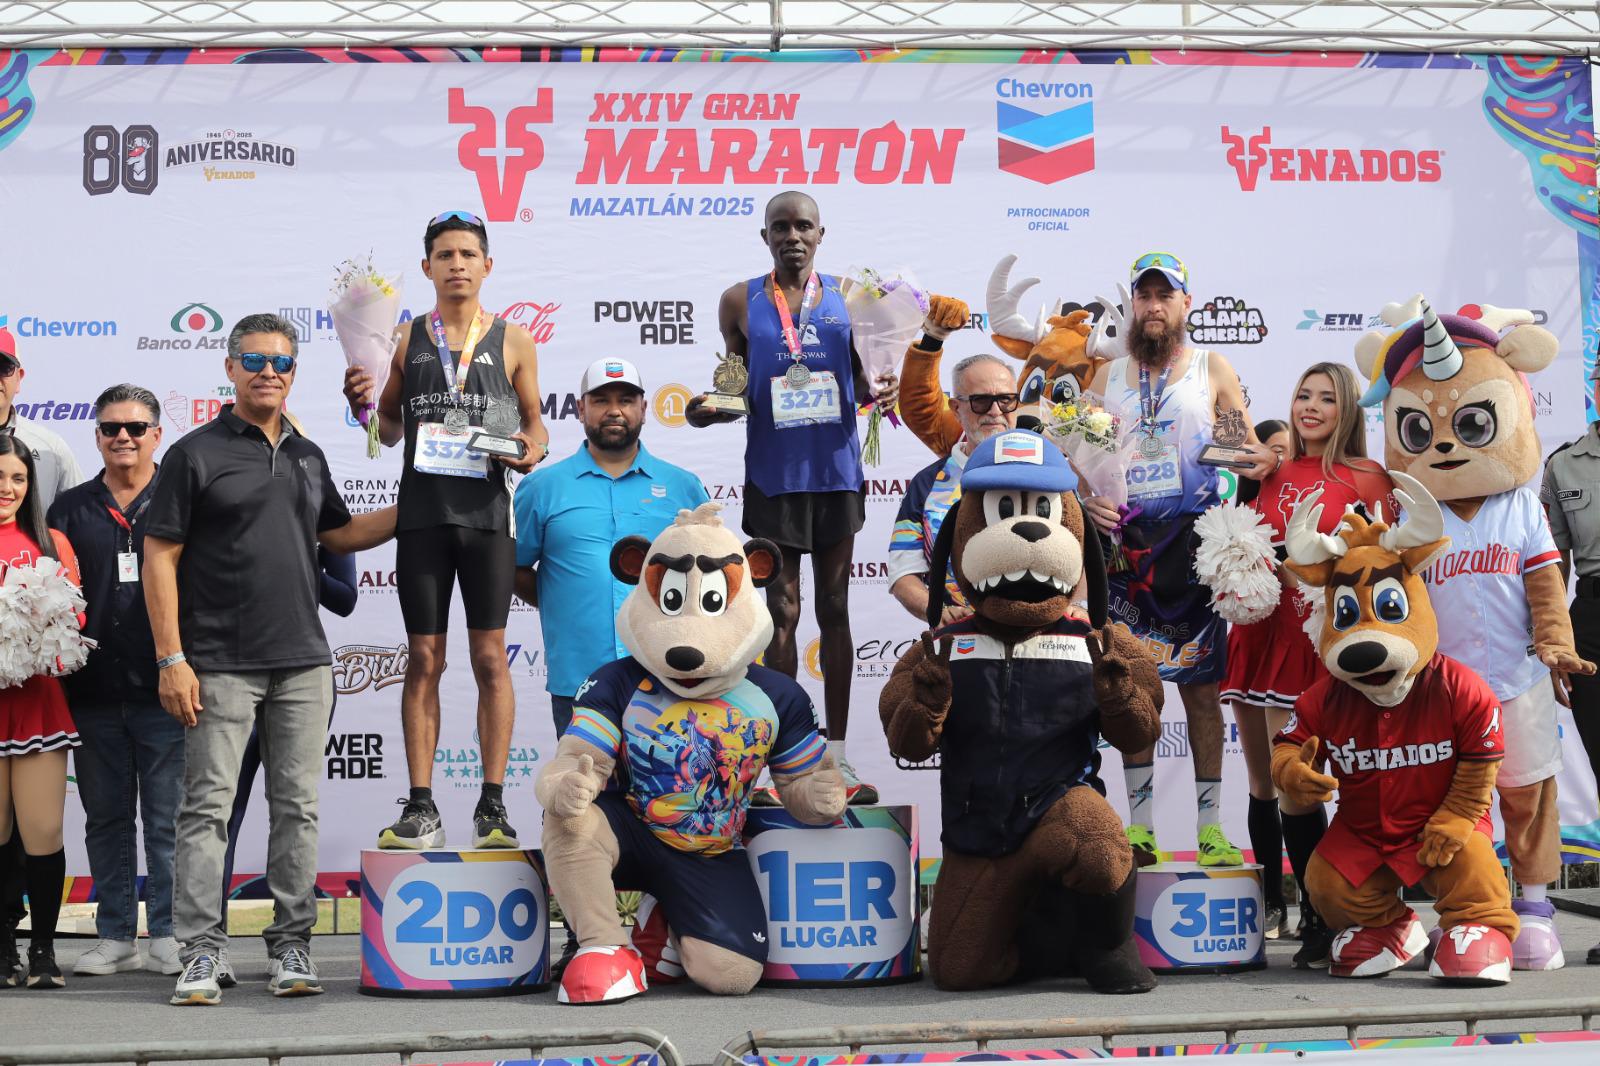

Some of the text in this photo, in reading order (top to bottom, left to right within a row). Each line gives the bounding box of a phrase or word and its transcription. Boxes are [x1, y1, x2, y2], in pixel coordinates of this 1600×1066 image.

[996, 78, 1093, 98] Chevron
[589, 93, 800, 122] XXIV GRAN
[166, 140, 295, 167] ANIVERSARIO
[575, 120, 965, 185] MARATÓN
[569, 193, 754, 216] MAZATLÁN 2025
[1007, 208, 1090, 219] PATROCINADOR
[1028, 221, 1069, 231] OFICIAL
[594, 301, 694, 323] POWER
[1216, 299, 1234, 310] LA
[17, 317, 117, 338] Chevron
[1190, 310, 1262, 326] CLAMA
[1324, 314, 1363, 326] ETN
[137, 336, 229, 350] Banco Azt
[640, 323, 694, 345] ADE
[780, 388, 833, 410] 3271
[422, 440, 482, 461] 337
[343, 480, 387, 491] GRAN
[343, 493, 398, 504] MAZAT
[856, 640, 892, 660] El
[324, 734, 383, 756] WER
[328, 757, 383, 780] ADE
[757, 850, 898, 922] 1ER
[396, 880, 539, 943] 2DO
[1170, 893, 1258, 937] 3ER
[780, 926, 877, 948] LUGAR
[1193, 938, 1247, 953] LUGAR
[430, 946, 514, 966] LUGAR
